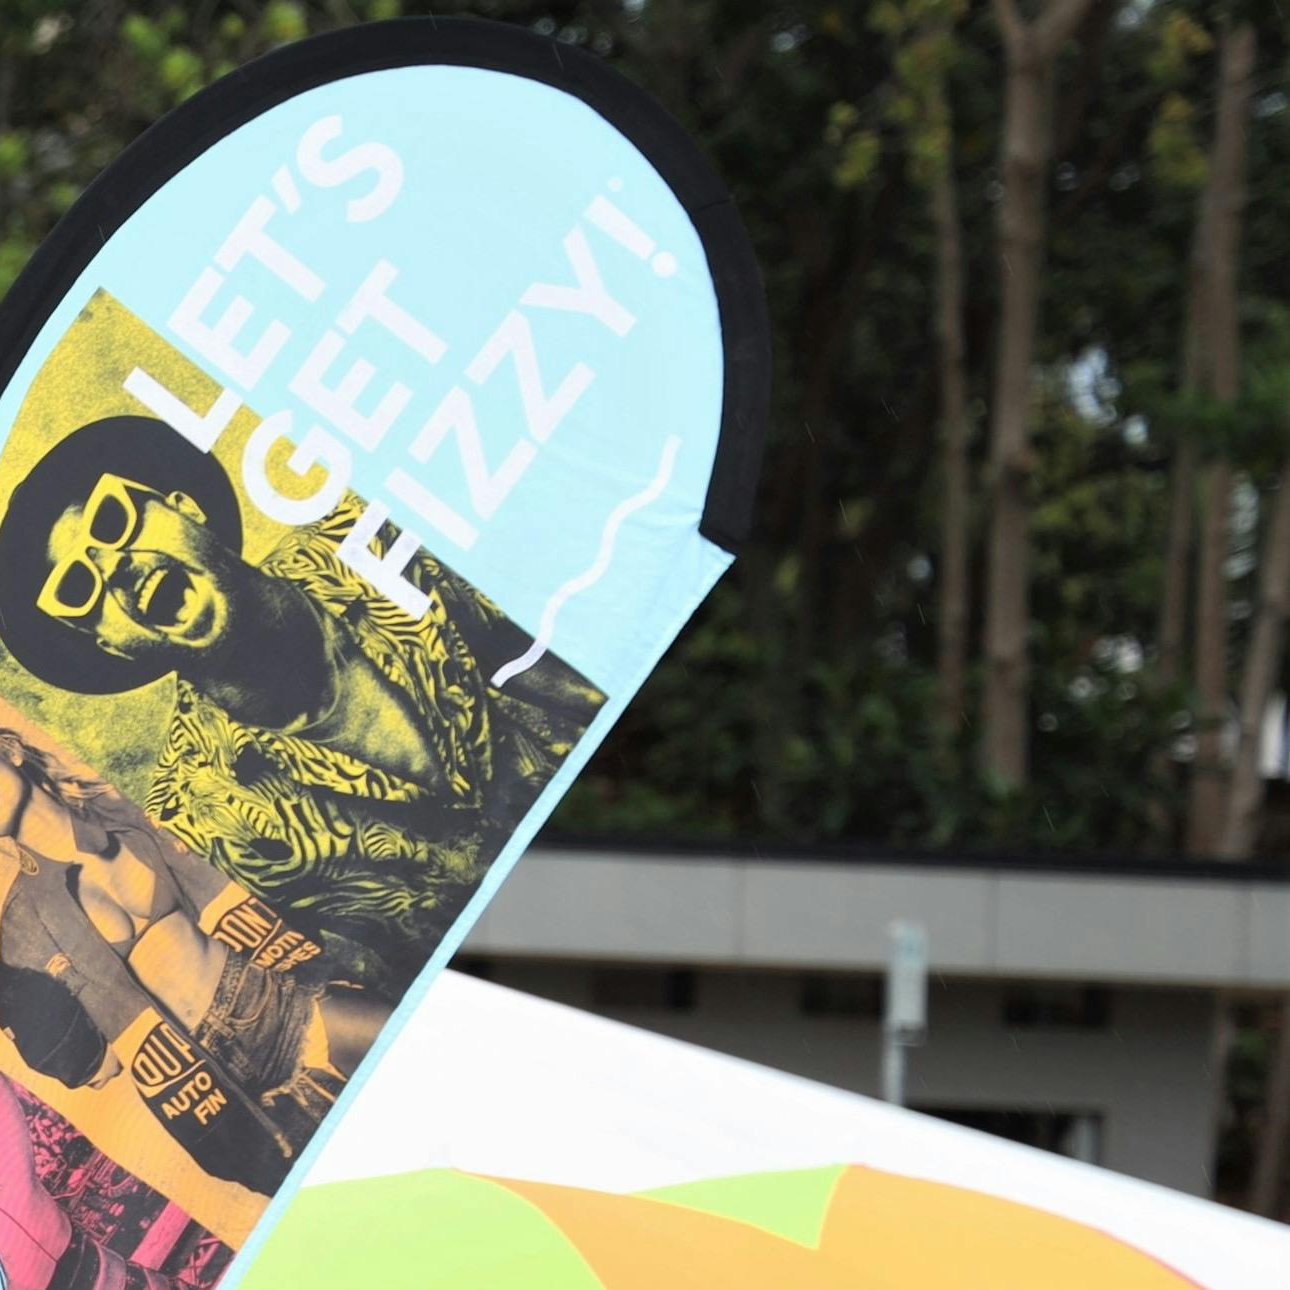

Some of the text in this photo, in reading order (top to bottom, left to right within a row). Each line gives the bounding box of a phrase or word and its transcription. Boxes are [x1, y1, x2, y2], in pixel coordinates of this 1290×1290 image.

[122, 115, 404, 454] LET'S
[242, 258, 449, 526] GET
[336, 196, 678, 620] FIZZY!
[161, 1071, 212, 1119] AUTO
[194, 1088, 227, 1125] FIN
